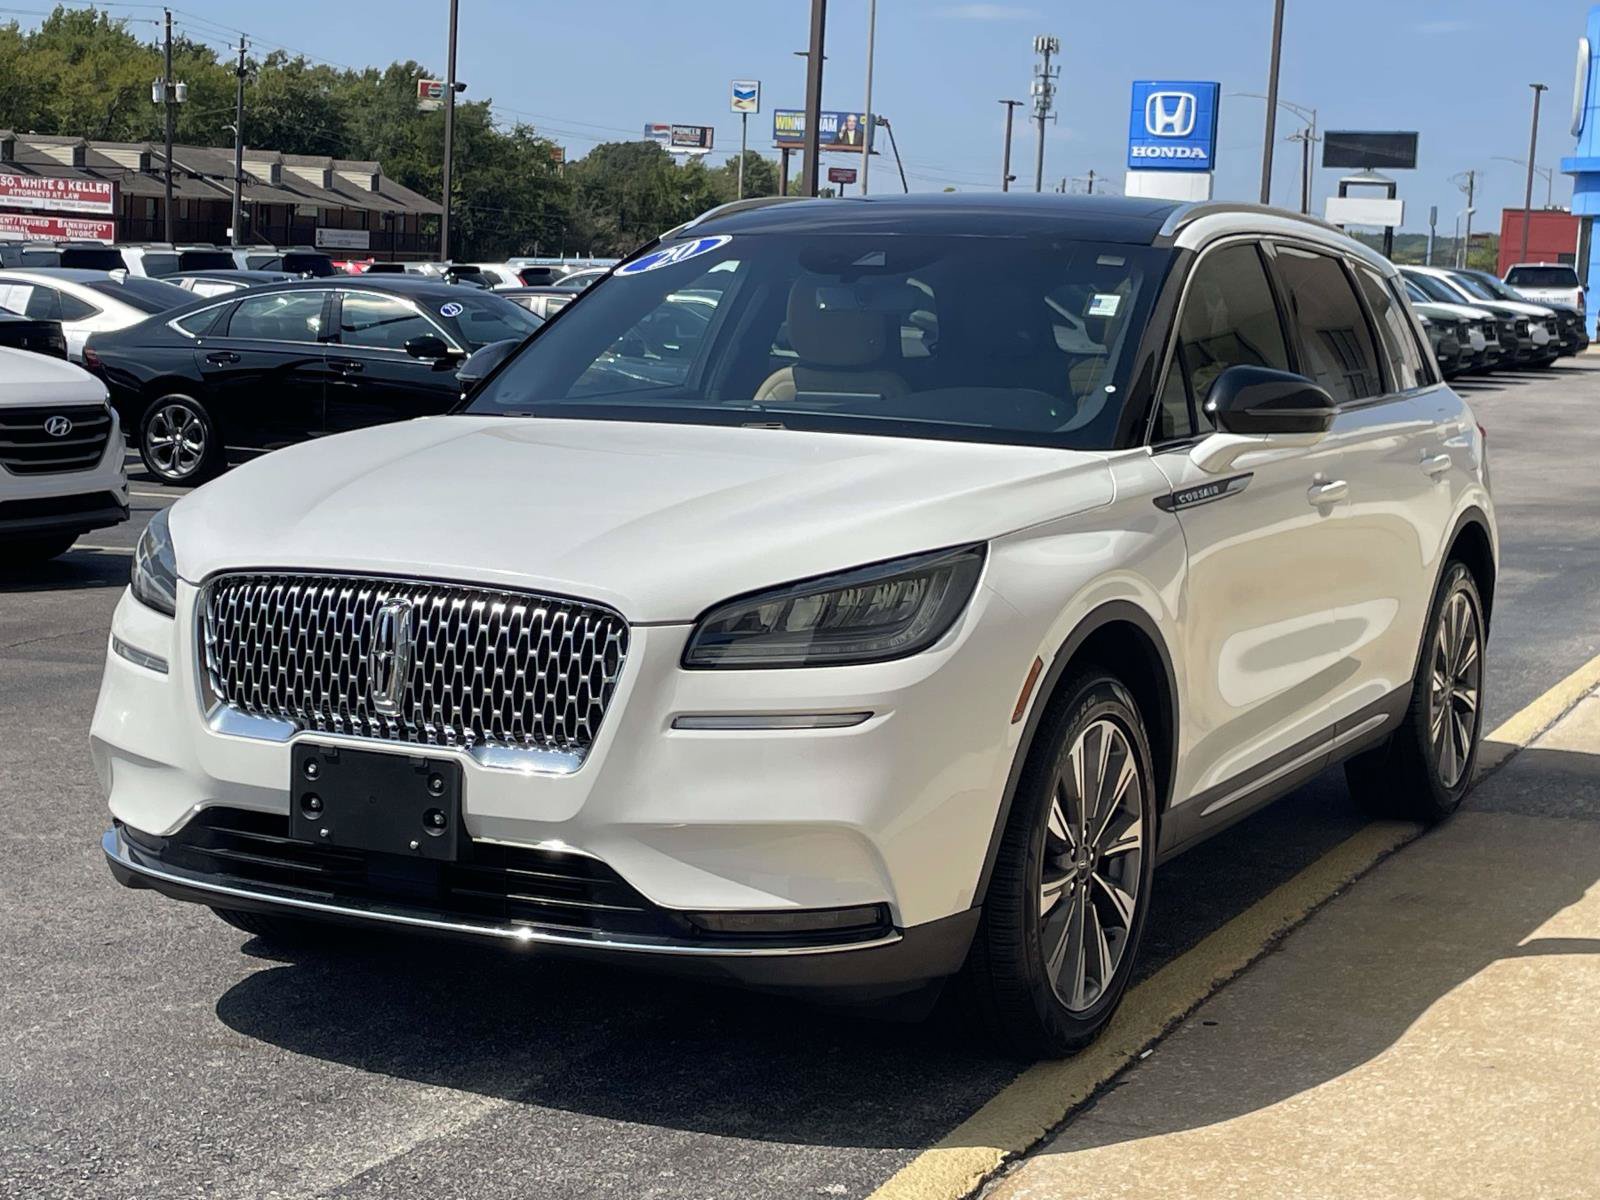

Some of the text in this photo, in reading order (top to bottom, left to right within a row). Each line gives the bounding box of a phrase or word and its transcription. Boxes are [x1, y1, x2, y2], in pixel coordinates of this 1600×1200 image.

[1132, 146, 1208, 159] HONDA
[20, 178, 55, 190] WHITE
[57, 181, 65, 190] &
[68, 181, 110, 194] KELLER
[8, 188, 50, 198] ATTORNEYS
[63, 191, 80, 200] LAW
[1178, 485, 1220, 504] CORSAIR
